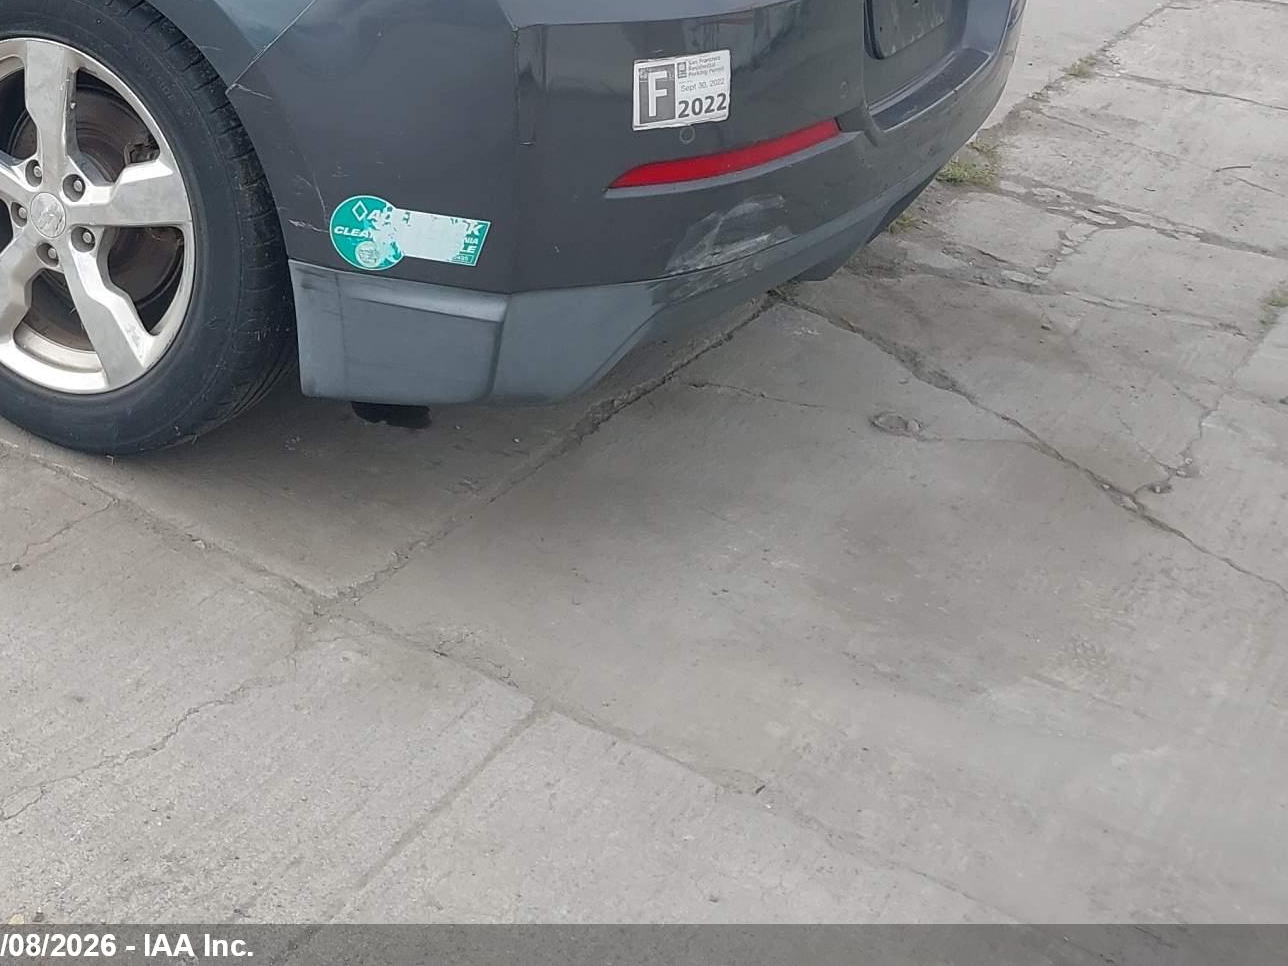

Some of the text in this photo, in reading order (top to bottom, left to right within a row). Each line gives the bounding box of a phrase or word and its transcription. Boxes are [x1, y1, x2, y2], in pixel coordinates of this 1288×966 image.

[648, 70, 667, 117] F
[680, 83, 697, 92] Sept
[678, 92, 727, 119] 2022
[334, 225, 373, 239] CLEA
